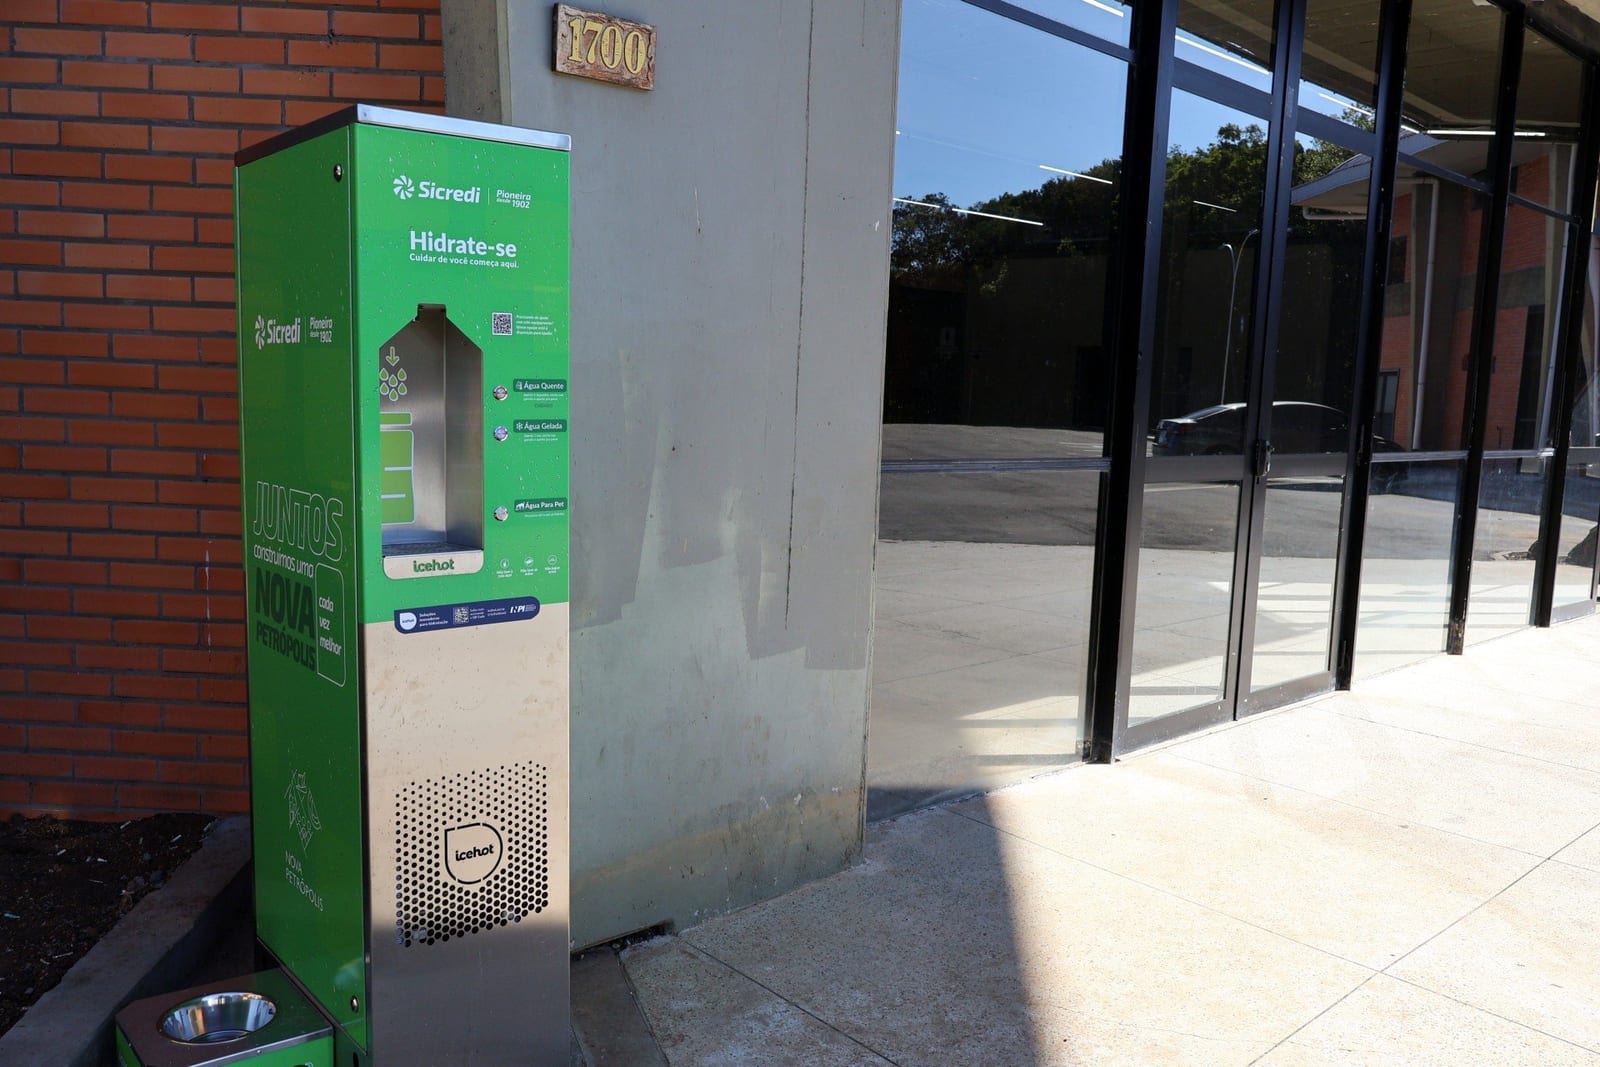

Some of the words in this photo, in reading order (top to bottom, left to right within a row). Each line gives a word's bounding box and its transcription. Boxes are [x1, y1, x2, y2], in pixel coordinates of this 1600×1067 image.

[567, 18, 647, 75] 1700
[418, 181, 480, 203] Sicredi
[496, 189, 531, 201] Pioneira
[512, 199, 530, 209] 1902
[410, 230, 517, 257] Hidrate-se
[409, 253, 436, 262] Cuidar
[437, 255, 448, 263] de
[449, 256, 468, 265] você
[469, 258, 499, 268] começa
[500, 261, 519, 269] aqui.
[267, 317, 301, 344] Sicredi
[309, 316, 333, 329] Pioneira
[320, 331, 333, 343] 1902
[523, 381, 541, 390] Água
[540, 382, 565, 390] Quente
[524, 421, 541, 430] Água
[541, 422, 563, 430] Gelada
[524, 502, 540, 510] Água
[253, 480, 344, 562] JUNTOS
[253, 543, 296, 572] construímos
[296, 559, 314, 579] uma
[413, 559, 455, 573] icehot
[255, 567, 316, 640] NOVA
[318, 596, 334, 613] cada
[319, 615, 331, 631] vez
[255, 619, 317, 673] PETRÓPOLIS
[319, 635, 343, 656] melhor
[455, 844, 494, 861] icehot
[285, 849, 304, 877] NOVA
[285, 867, 324, 912] PETRÓPOLIS
